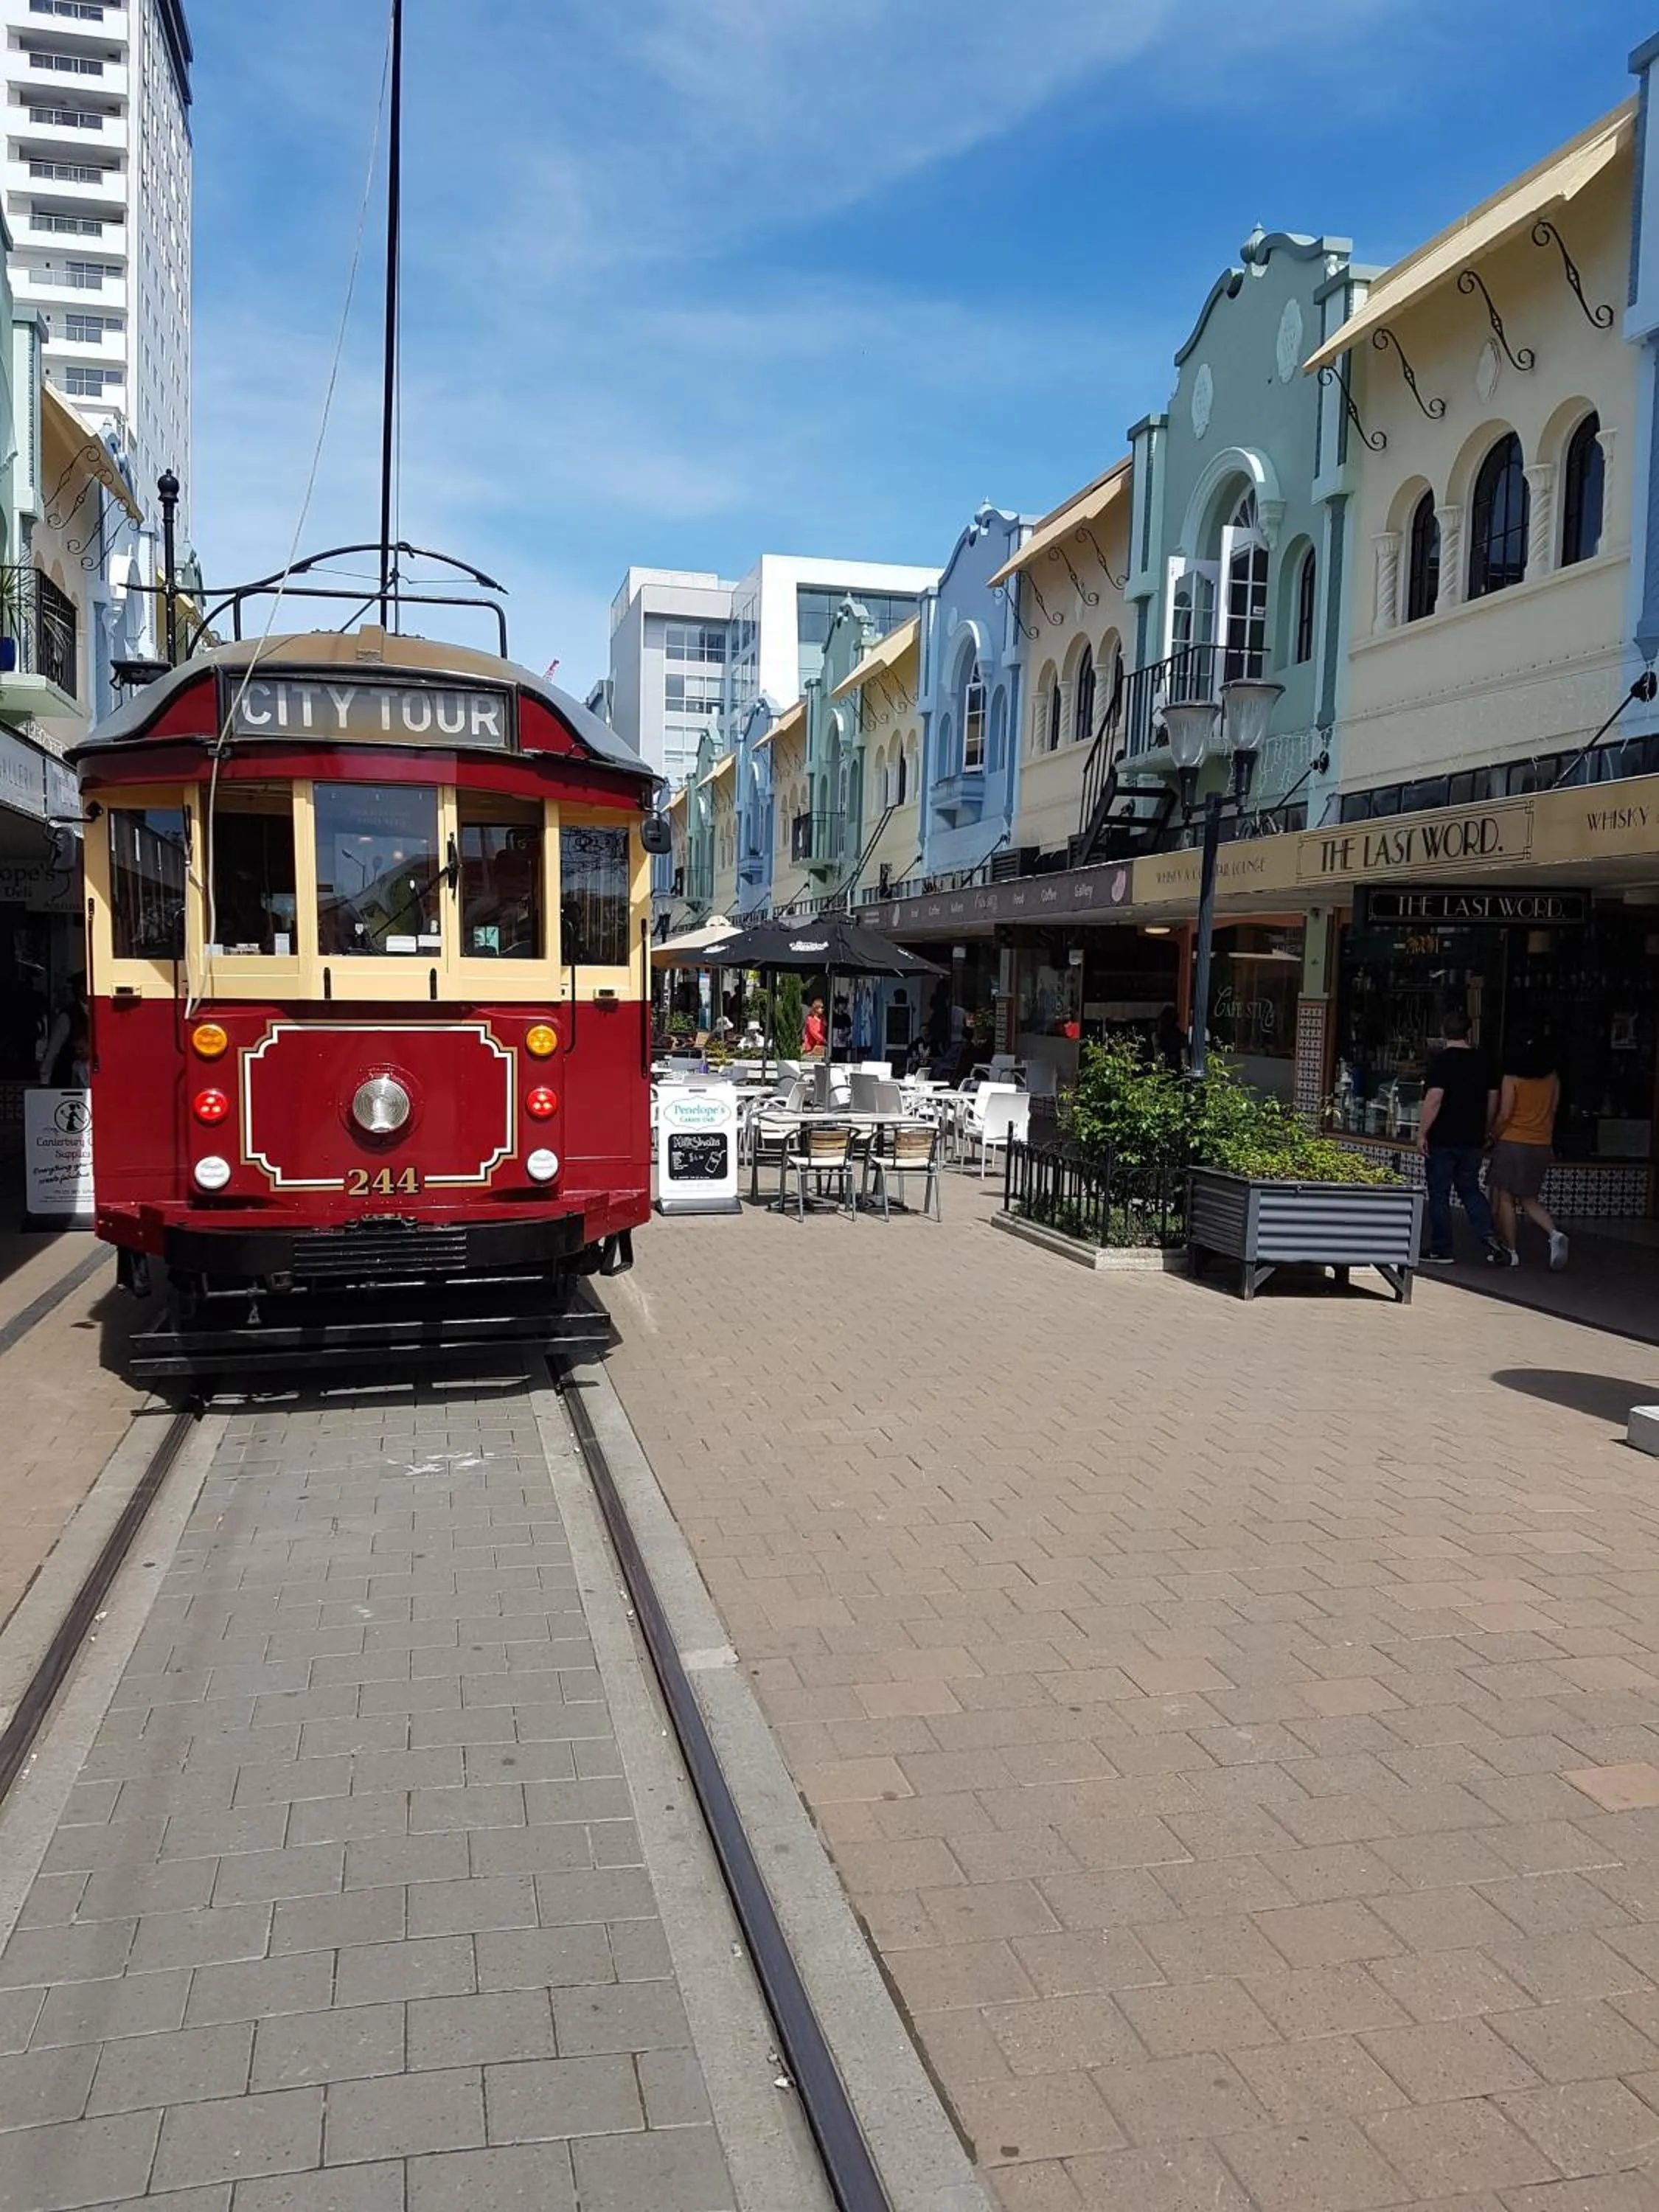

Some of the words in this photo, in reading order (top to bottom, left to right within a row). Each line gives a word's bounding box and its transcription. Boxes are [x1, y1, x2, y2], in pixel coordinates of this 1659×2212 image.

[242, 683, 358, 728] CITY
[370, 689, 501, 737] TOUR
[1587, 805, 1649, 832] WHISKY
[1321, 837, 1356, 872] THE
[1363, 827, 1417, 868] LAST
[1422, 818, 1503, 860] WORD.
[1399, 895, 1434, 917] THE
[1442, 895, 1494, 917] LAST
[1498, 897, 1566, 919] WORD.
[675, 1105, 726, 1115] Penelope's
[36, 1137, 85, 1148] Canterbury
[347, 1167, 420, 1195] 244
